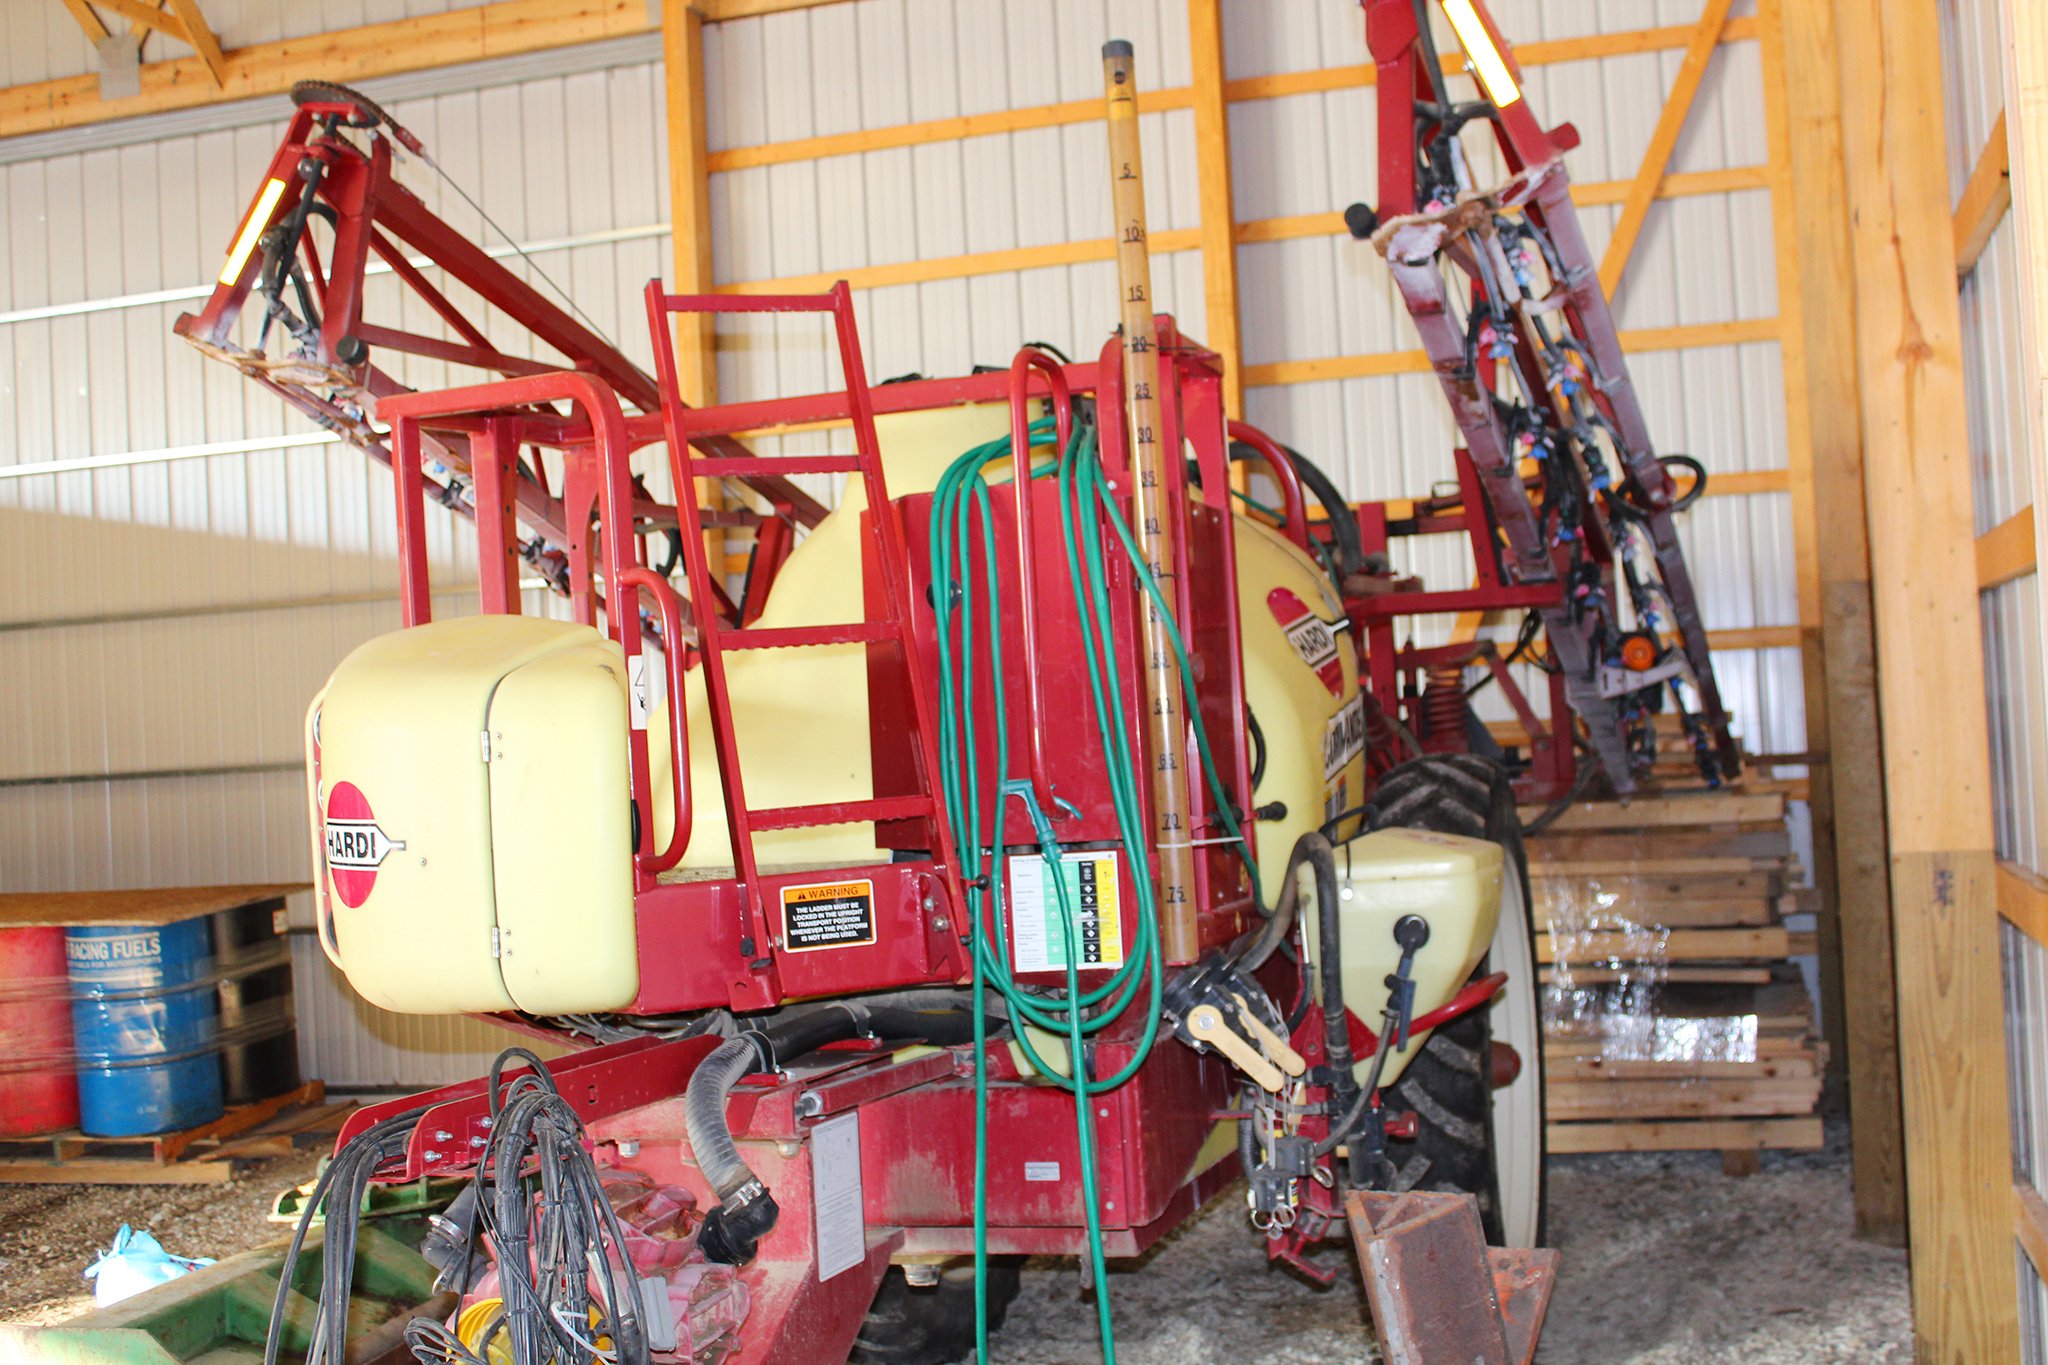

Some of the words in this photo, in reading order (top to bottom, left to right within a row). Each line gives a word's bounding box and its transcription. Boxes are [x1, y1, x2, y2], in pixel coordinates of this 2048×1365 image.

[1123, 163, 1131, 176] 5
[1125, 226, 1140, 241] 10
[1128, 285, 1143, 299] 15
[1135, 383, 1150, 398] 25
[1137, 427, 1153, 442] 30
[1141, 471, 1155, 486] 35
[1145, 518, 1158, 532] 40
[1292, 621, 1333, 660] HARDI
[1159, 753, 1175, 768] 65
[1162, 813, 1179, 829] 70
[328, 831, 377, 859] HARDI
[808, 886, 858, 899] WARNING
[1168, 887, 1184, 902] 75
[792, 912, 818, 922] LOCKED
[837, 908, 863, 918] UPRIGHT
[795, 906, 809, 914] THE
[808, 904, 833, 913] LADDER
[833, 902, 850, 911] MUST
[850, 901, 859, 909] BE
[790, 926, 824, 936] WHENEVER
[824, 924, 837, 932] THE
[836, 922, 868, 931] PLATFORM
[797, 919, 833, 928] TRANSPORT
[833, 915, 861, 924] POSITION
[112, 937, 161, 959] FUELS
